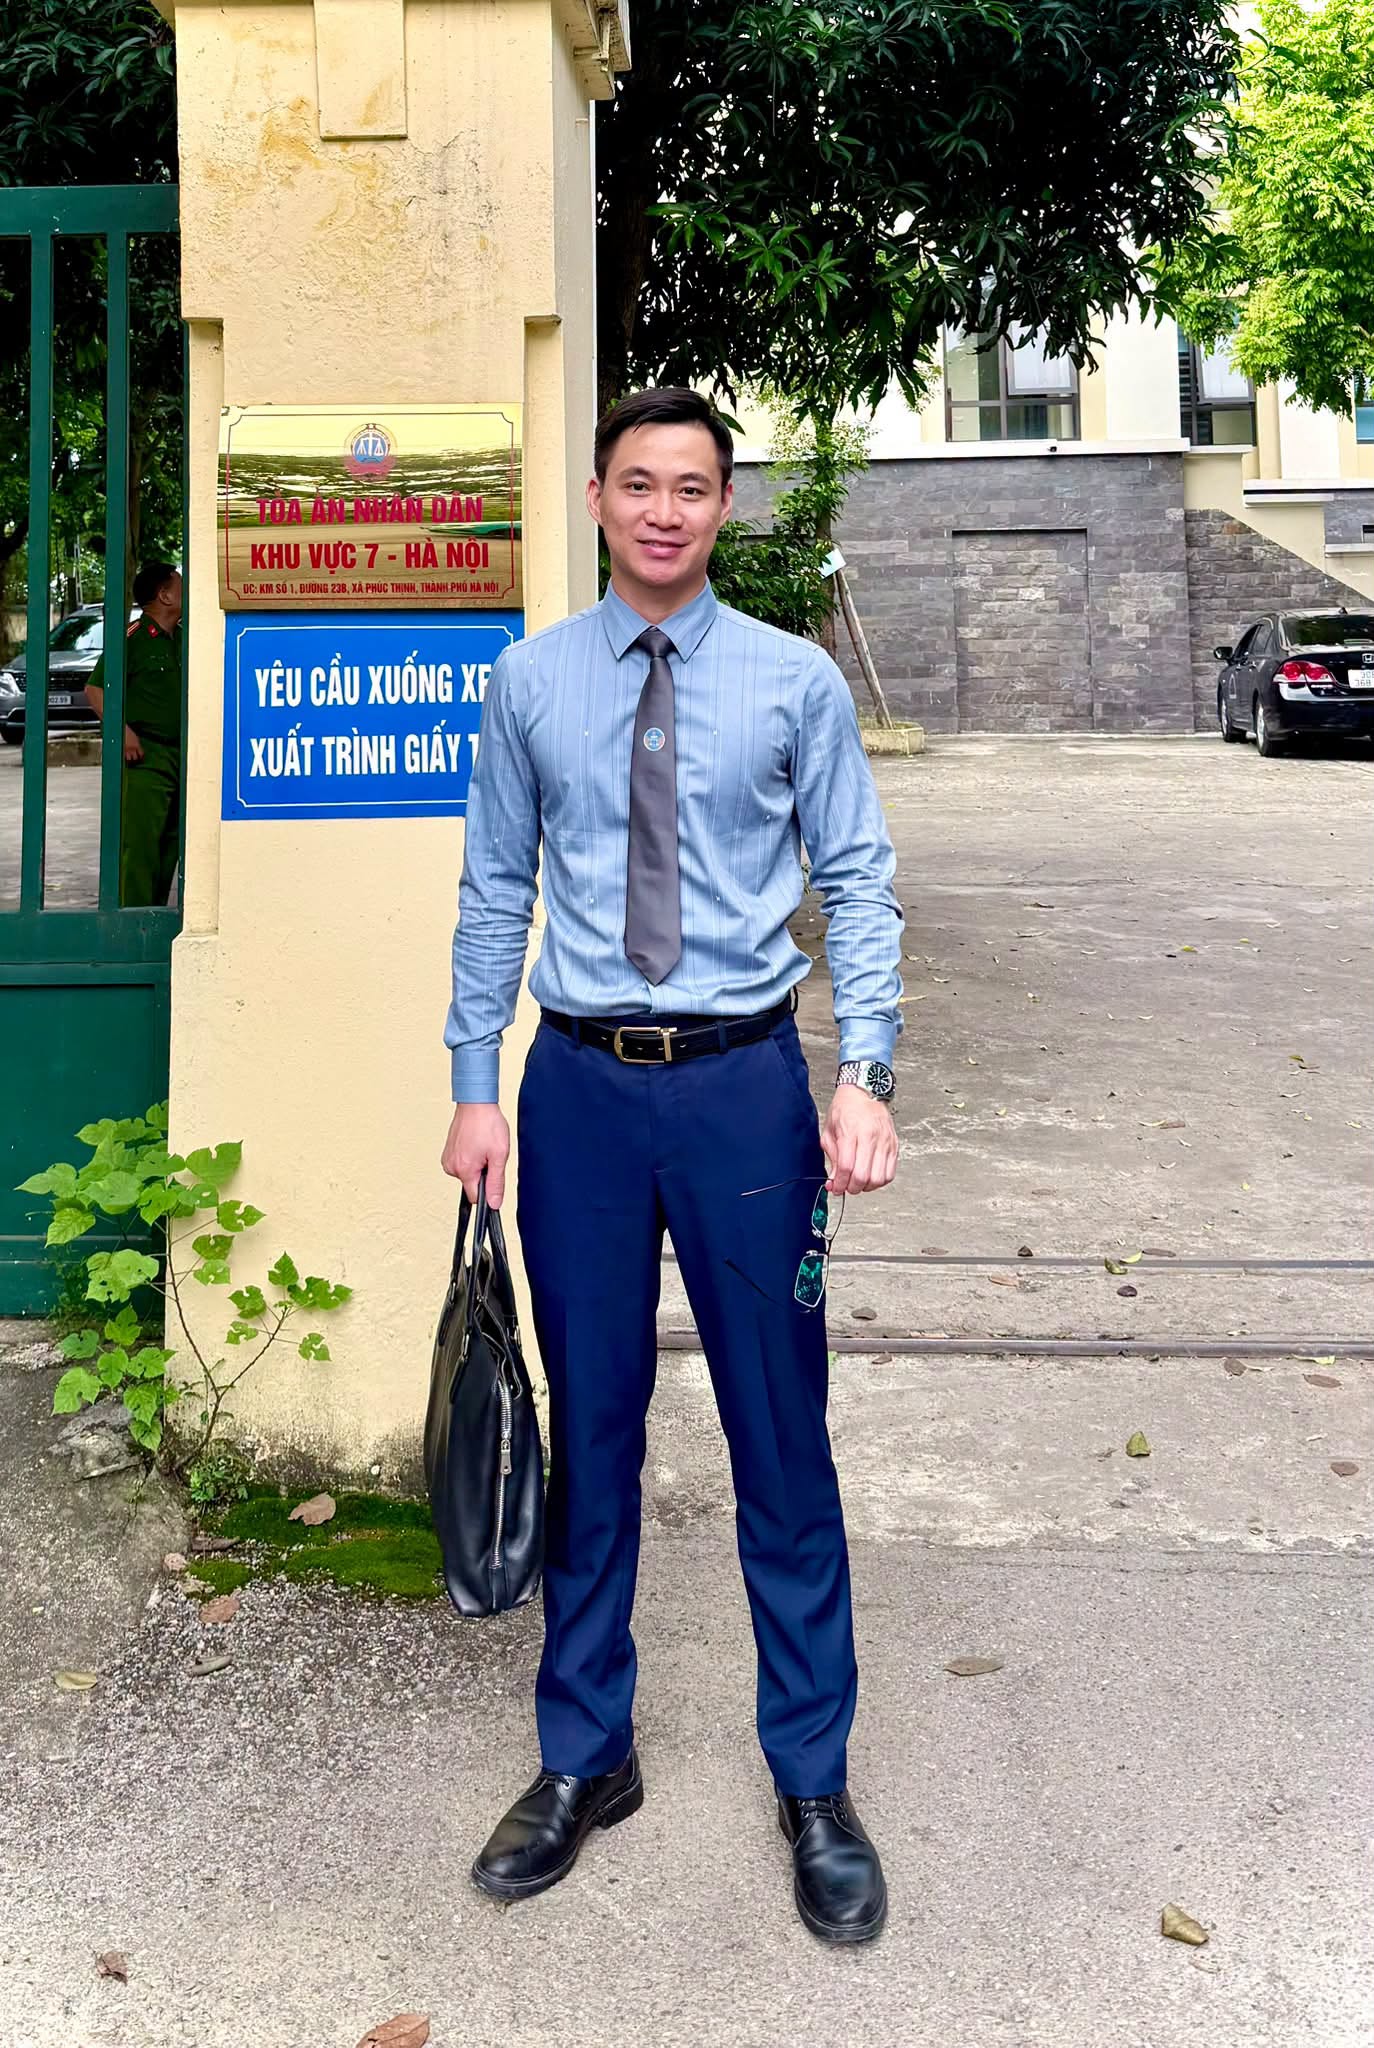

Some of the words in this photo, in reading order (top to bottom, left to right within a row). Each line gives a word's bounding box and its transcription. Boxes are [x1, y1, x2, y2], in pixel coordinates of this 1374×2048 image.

[353, 491, 423, 524] NHÂN
[432, 490, 483, 524] DÂN
[251, 543, 300, 570] KHU
[309, 540, 357, 574] VỰC
[364, 543, 379, 568] 7
[405, 537, 438, 568] HÀ
[446, 536, 488, 574] NỘI
[260, 583, 274, 594] KM
[276, 579, 287, 594] SỐ
[300, 580, 329, 594] ĐƯỜNG
[366, 580, 388, 593] PHÚC
[420, 580, 448, 593] THÀNH
[451, 579, 467, 593] PHỐ
[470, 580, 482, 593] HÀ
[484, 579, 499, 595] NỘI
[255, 660, 302, 708] YÊU
[310, 652, 360, 706] CẦU
[367, 650, 453, 705] XUỐNG
[250, 722, 314, 777] XUẤT
[321, 727, 396, 776] TRÌNH
[404, 719, 461, 774] GIẤY
